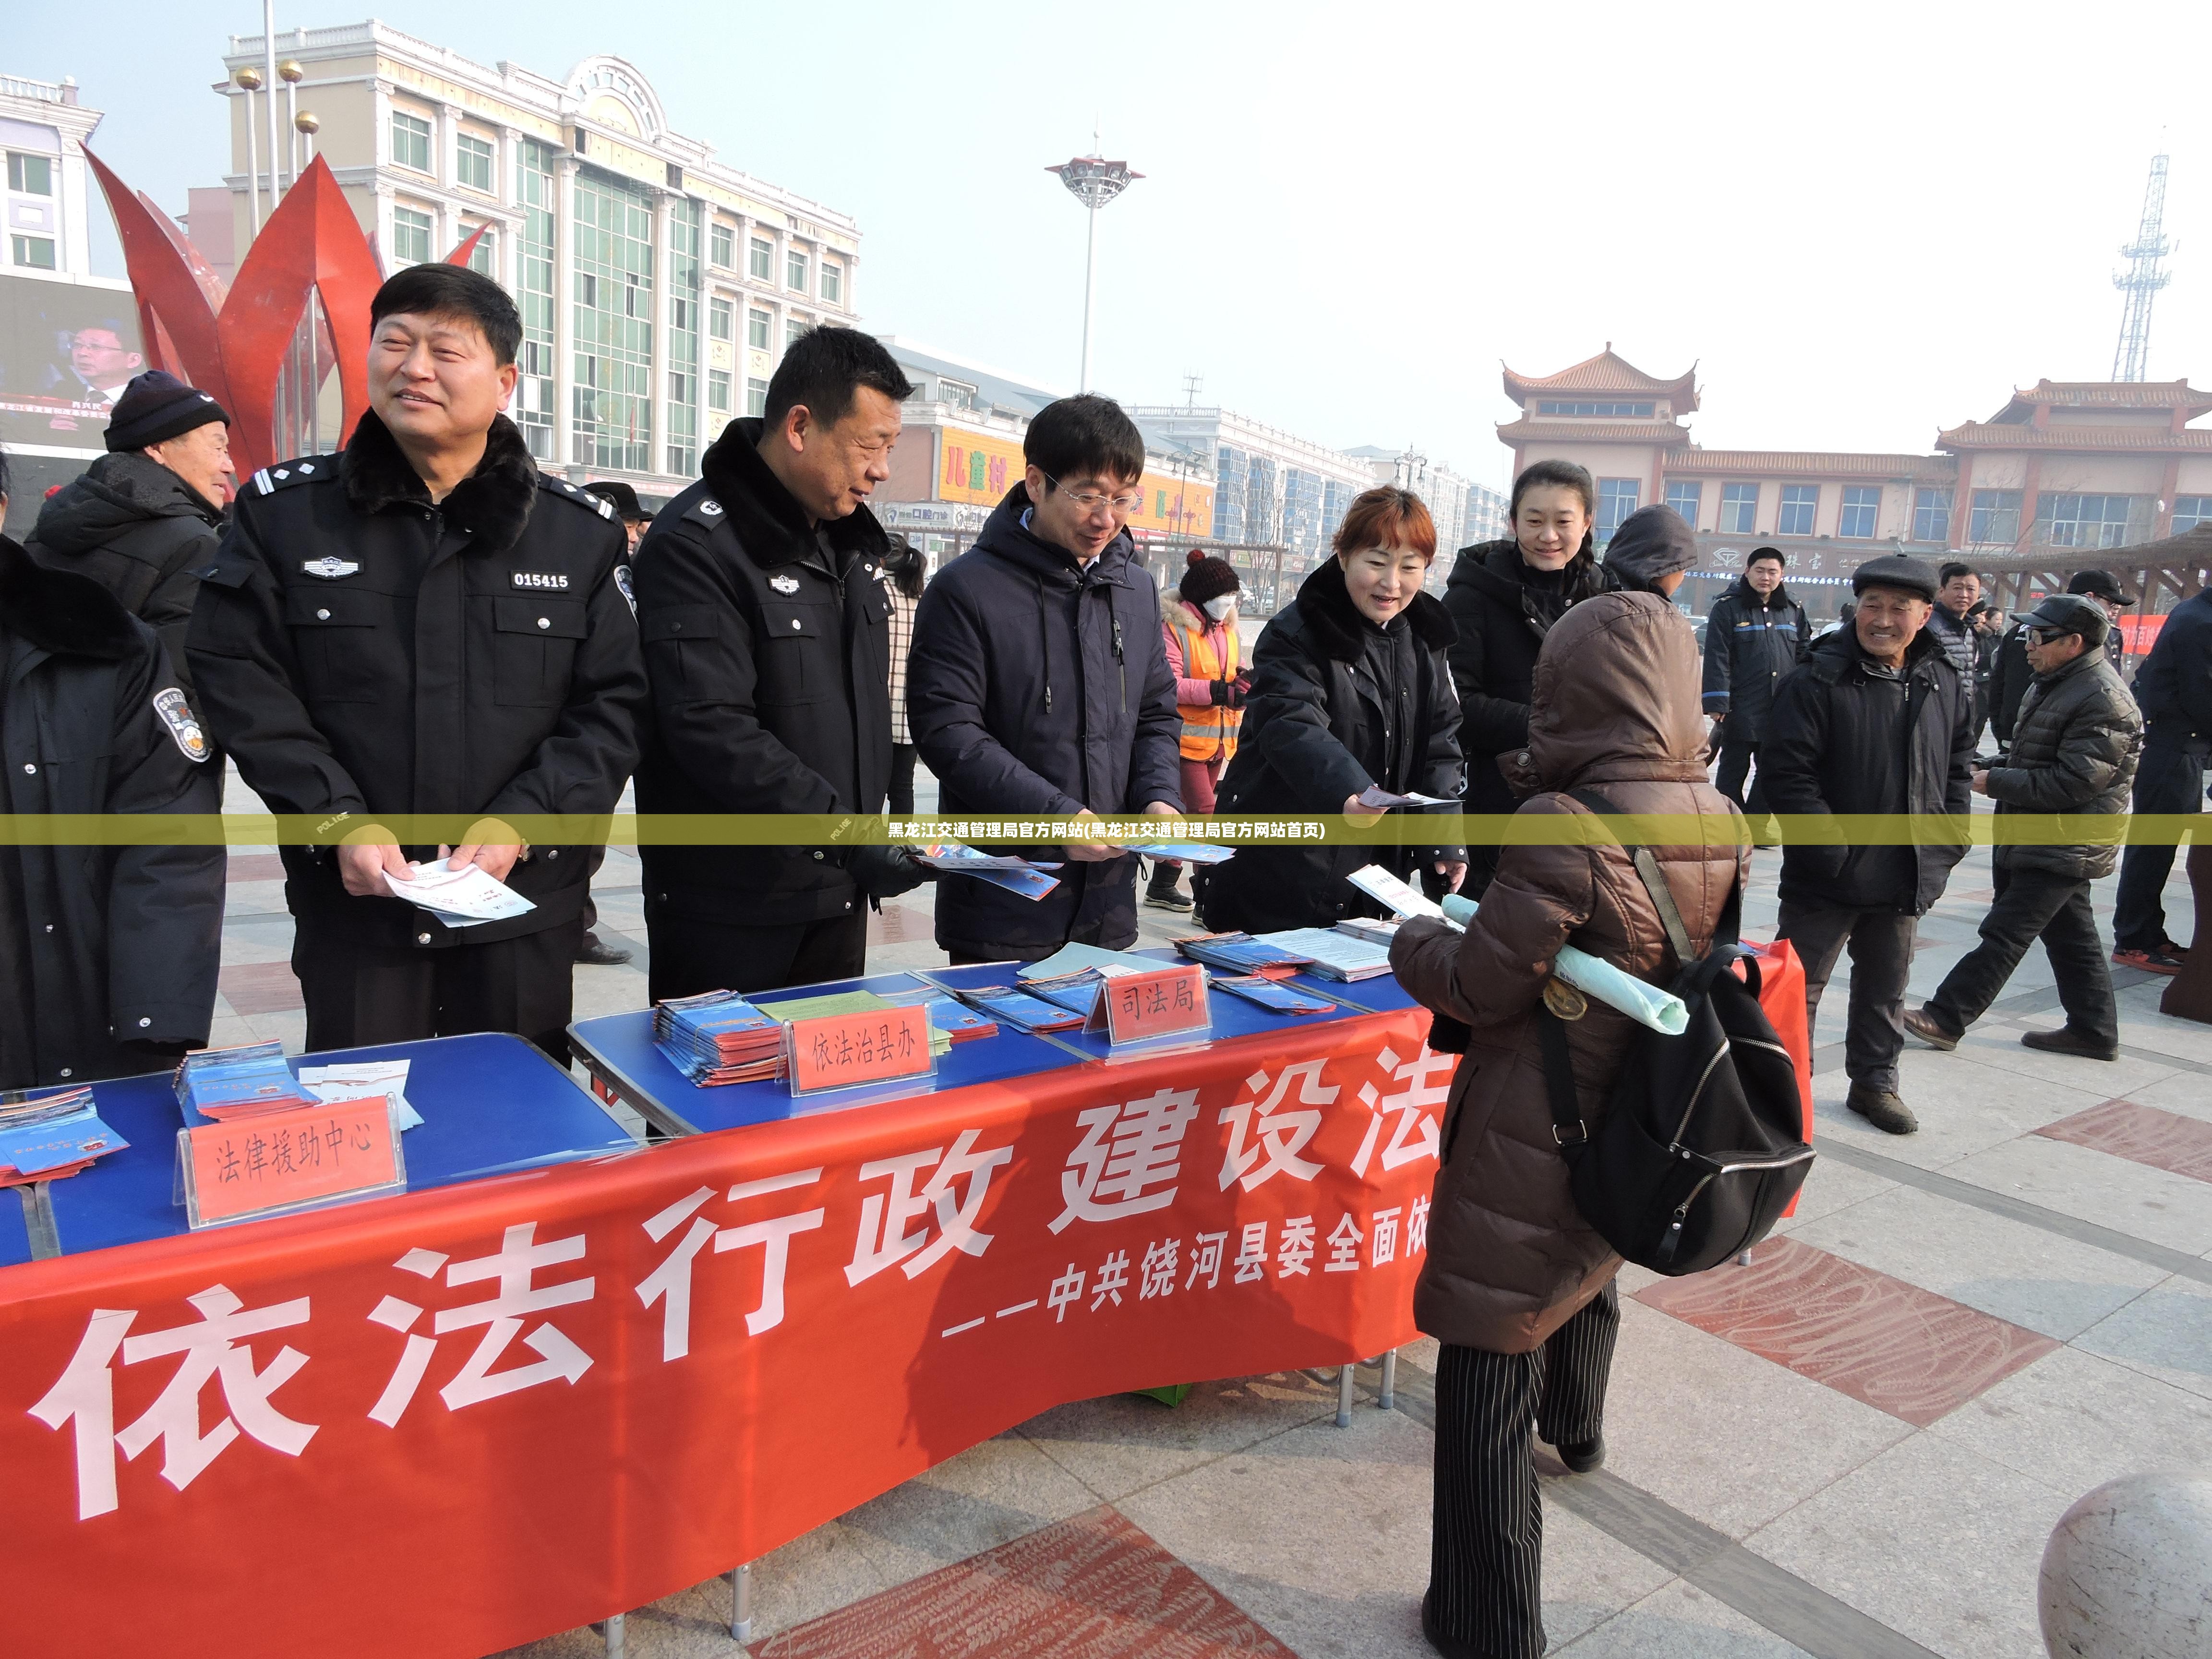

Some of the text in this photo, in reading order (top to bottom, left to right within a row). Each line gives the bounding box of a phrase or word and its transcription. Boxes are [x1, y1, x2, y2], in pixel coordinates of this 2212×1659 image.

[946, 446, 1007, 494] 儿童村
[1786, 552, 1822, 570] 珠宝
[515, 574, 568, 588] 015415
[316, 811, 350, 834] POLICE
[830, 818, 852, 841] POLICE
[1122, 979, 1194, 1021] 司法局
[812, 1020, 915, 1072] 依法治县办
[216, 1119, 371, 1184] 法律援助中心
